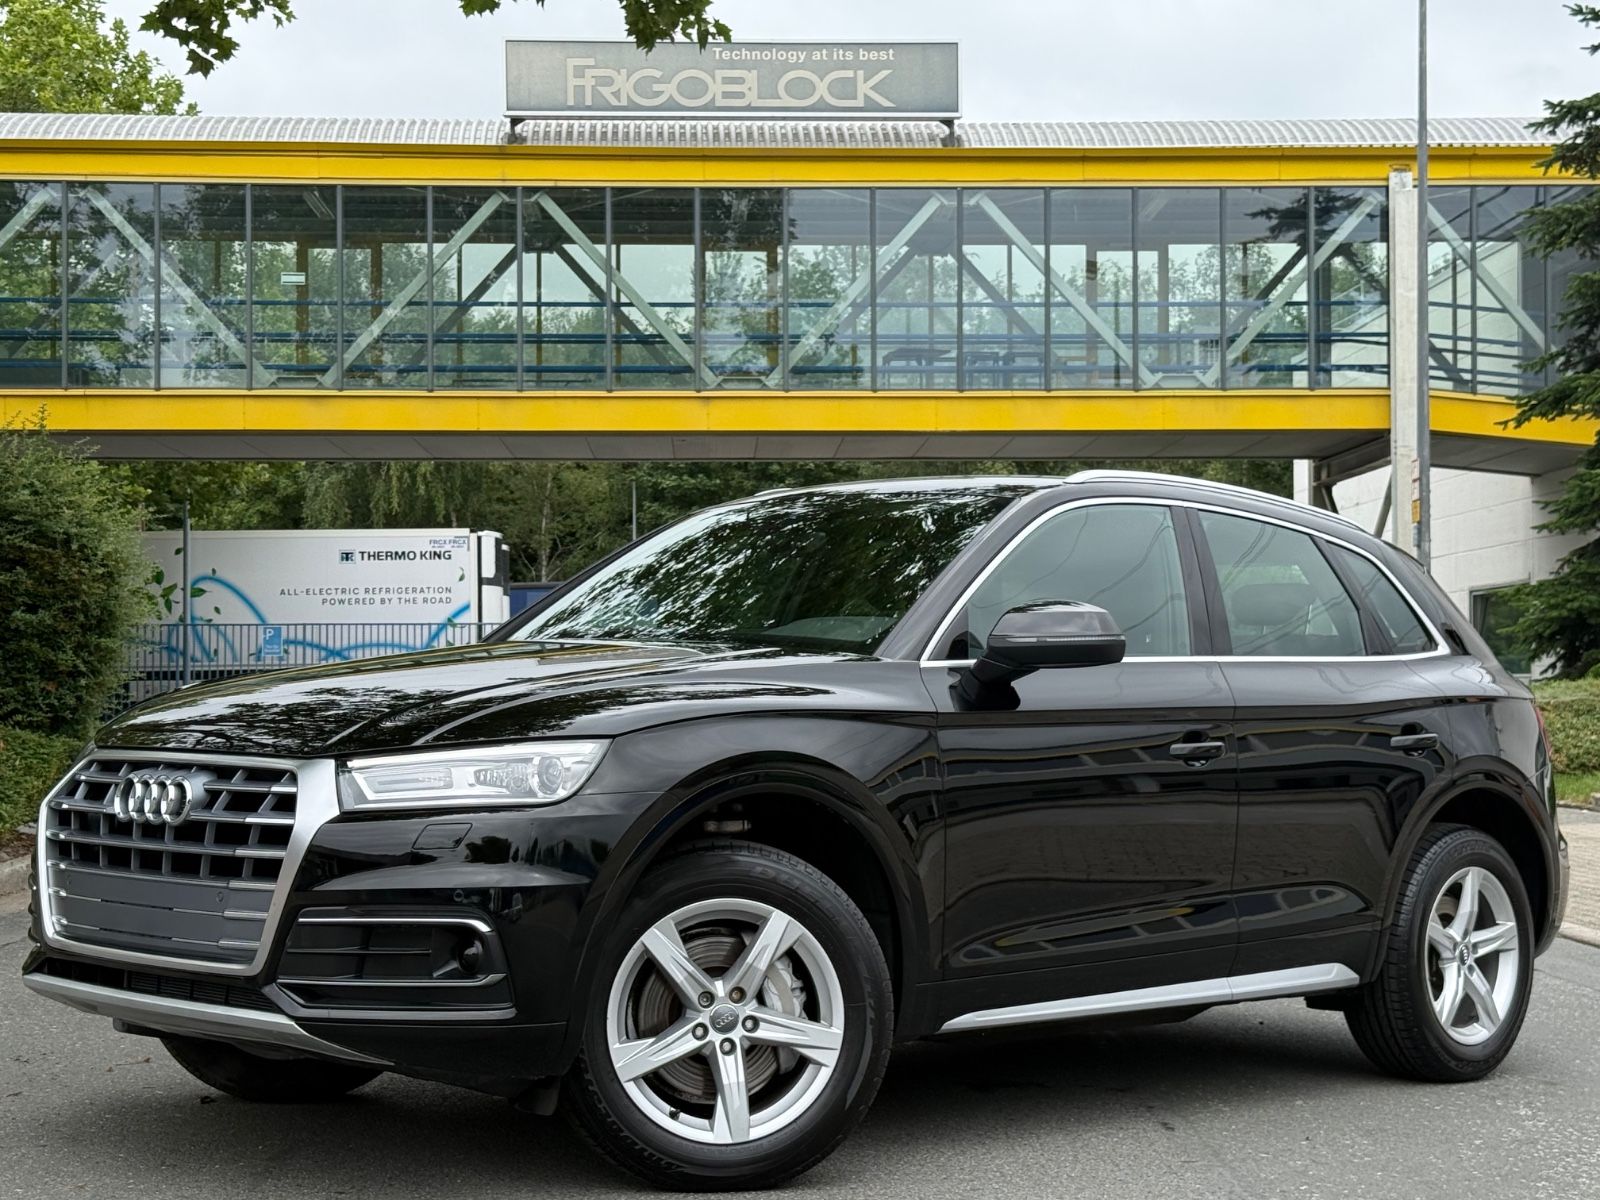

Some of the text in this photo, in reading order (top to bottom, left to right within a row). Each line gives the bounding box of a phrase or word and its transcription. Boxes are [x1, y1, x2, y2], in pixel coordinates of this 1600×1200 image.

[712, 48, 895, 63] Technology at its best
[565, 57, 896, 107] FRIGOBLOCK
[358, 550, 417, 561] THERMO
[419, 550, 452, 561] KING
[279, 586, 452, 596] ALL-ELECTRIC REFRIGERATION
[321, 596, 452, 606] POWERED BY THE ROAD
[266, 628, 275, 640] P
